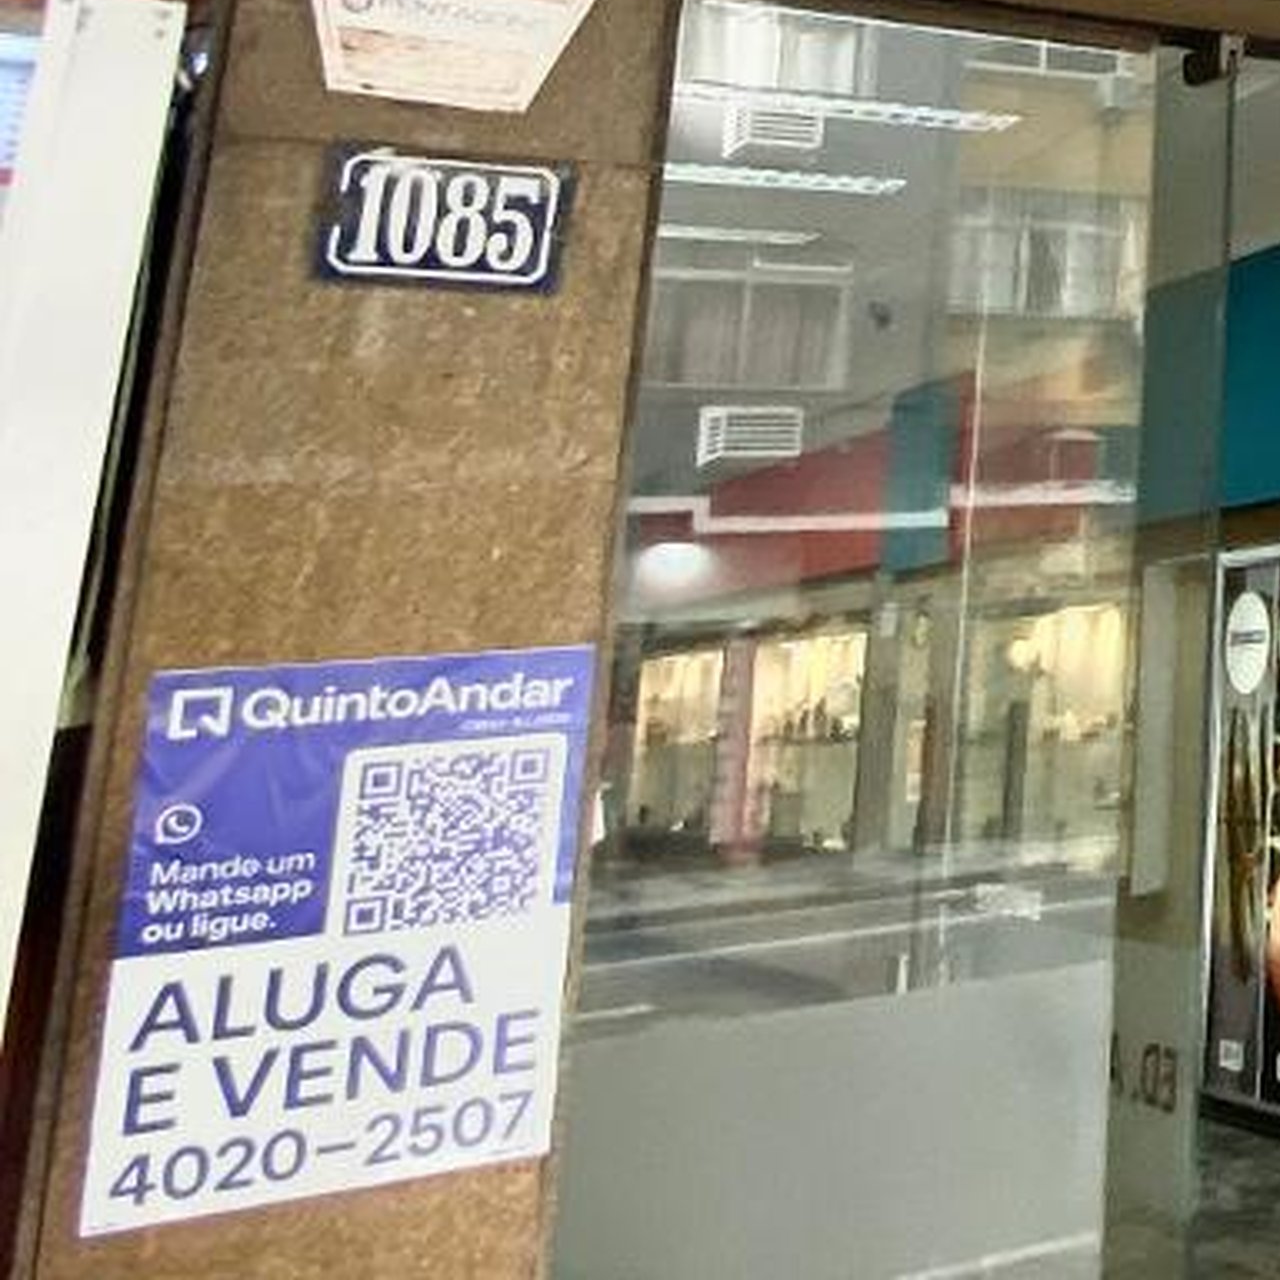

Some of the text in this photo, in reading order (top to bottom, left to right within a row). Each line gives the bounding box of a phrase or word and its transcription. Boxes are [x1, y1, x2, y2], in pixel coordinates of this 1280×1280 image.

[345, 162, 541, 272] 1085
[241, 672, 574, 730] QuintoAndar
[146, 879, 312, 915] Whatsapp
[150, 852, 316, 887] Mande um
[142, 911, 277, 944] ou ligue.
[127, 944, 475, 1053] ALUGA
[121, 1010, 541, 1137] E VENDE
[107, 1089, 535, 1207] 4020-2507
